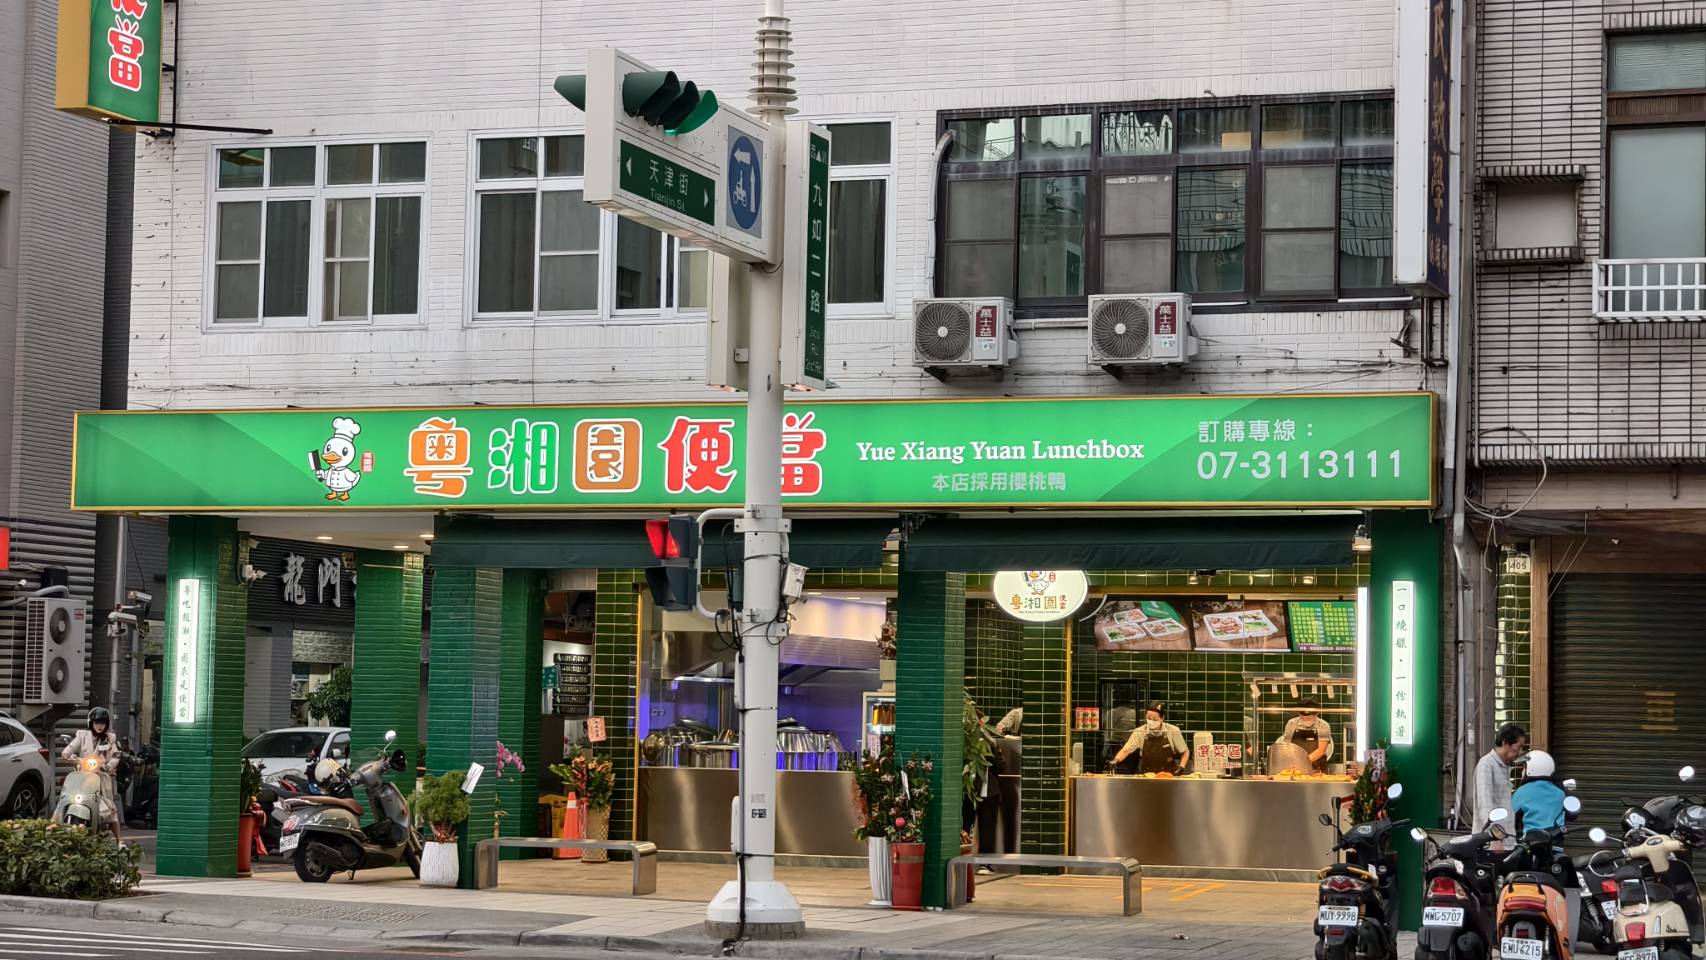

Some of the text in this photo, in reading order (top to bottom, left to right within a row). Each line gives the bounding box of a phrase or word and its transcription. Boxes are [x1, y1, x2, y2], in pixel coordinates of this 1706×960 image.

[108, 0, 147, 92] 當
[649, 159, 689, 196] 天津街
[650, 187, 676, 208] Tianjin
[810, 183, 822, 313] 九如二路
[856, 438, 1145, 464] Yue Xiang Yuan Lunchbox
[1196, 448, 1401, 479] 07-3113111
[931, 471, 1067, 492] 本店採用櫻桃鴨
[282, 551, 357, 608] 龍門
[1196, 743, 1242, 759] 選菜區
